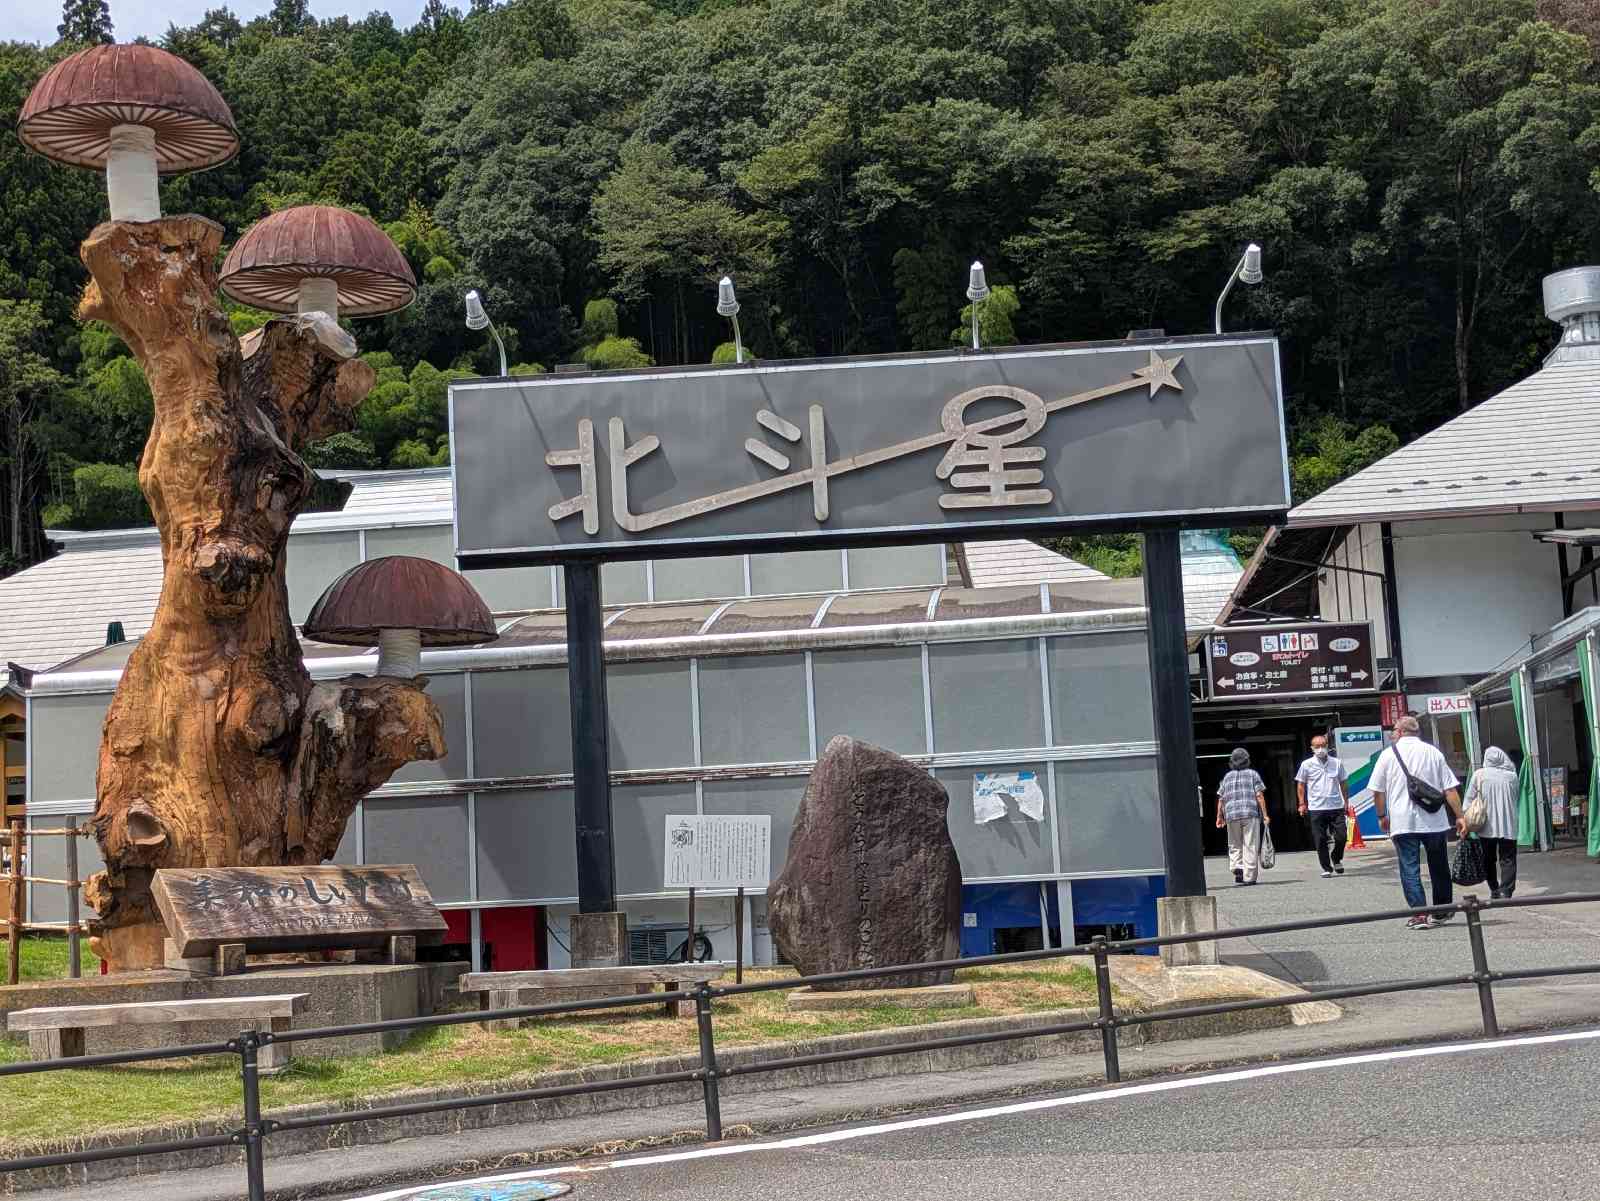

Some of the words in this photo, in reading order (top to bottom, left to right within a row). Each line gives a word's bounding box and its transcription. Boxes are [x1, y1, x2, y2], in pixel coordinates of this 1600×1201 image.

[545, 384, 1053, 535] 北斗星
[1430, 698, 1469, 712] 出入口
